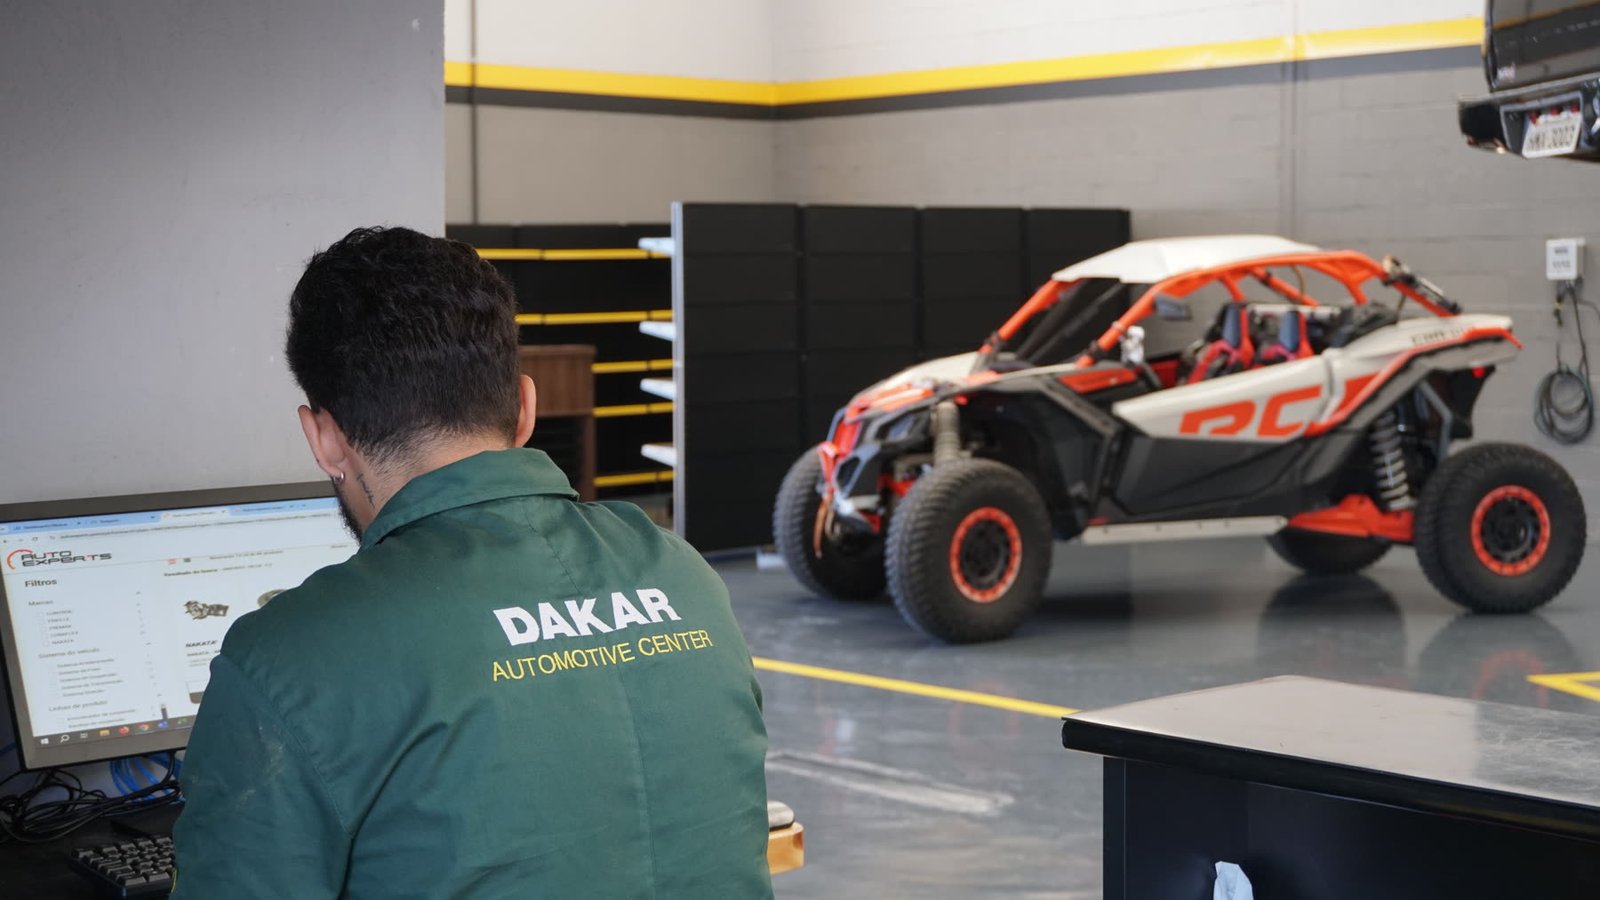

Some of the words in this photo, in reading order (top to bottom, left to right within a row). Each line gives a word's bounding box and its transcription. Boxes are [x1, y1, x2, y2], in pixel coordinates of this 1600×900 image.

[21, 550, 72, 561] AUTO
[22, 553, 112, 567] EXPERTS
[24, 579, 58, 588] Filtros
[493, 588, 682, 646] DAKAR
[492, 642, 635, 682] AUTOMOTIVE
[638, 629, 714, 657] CENTER
